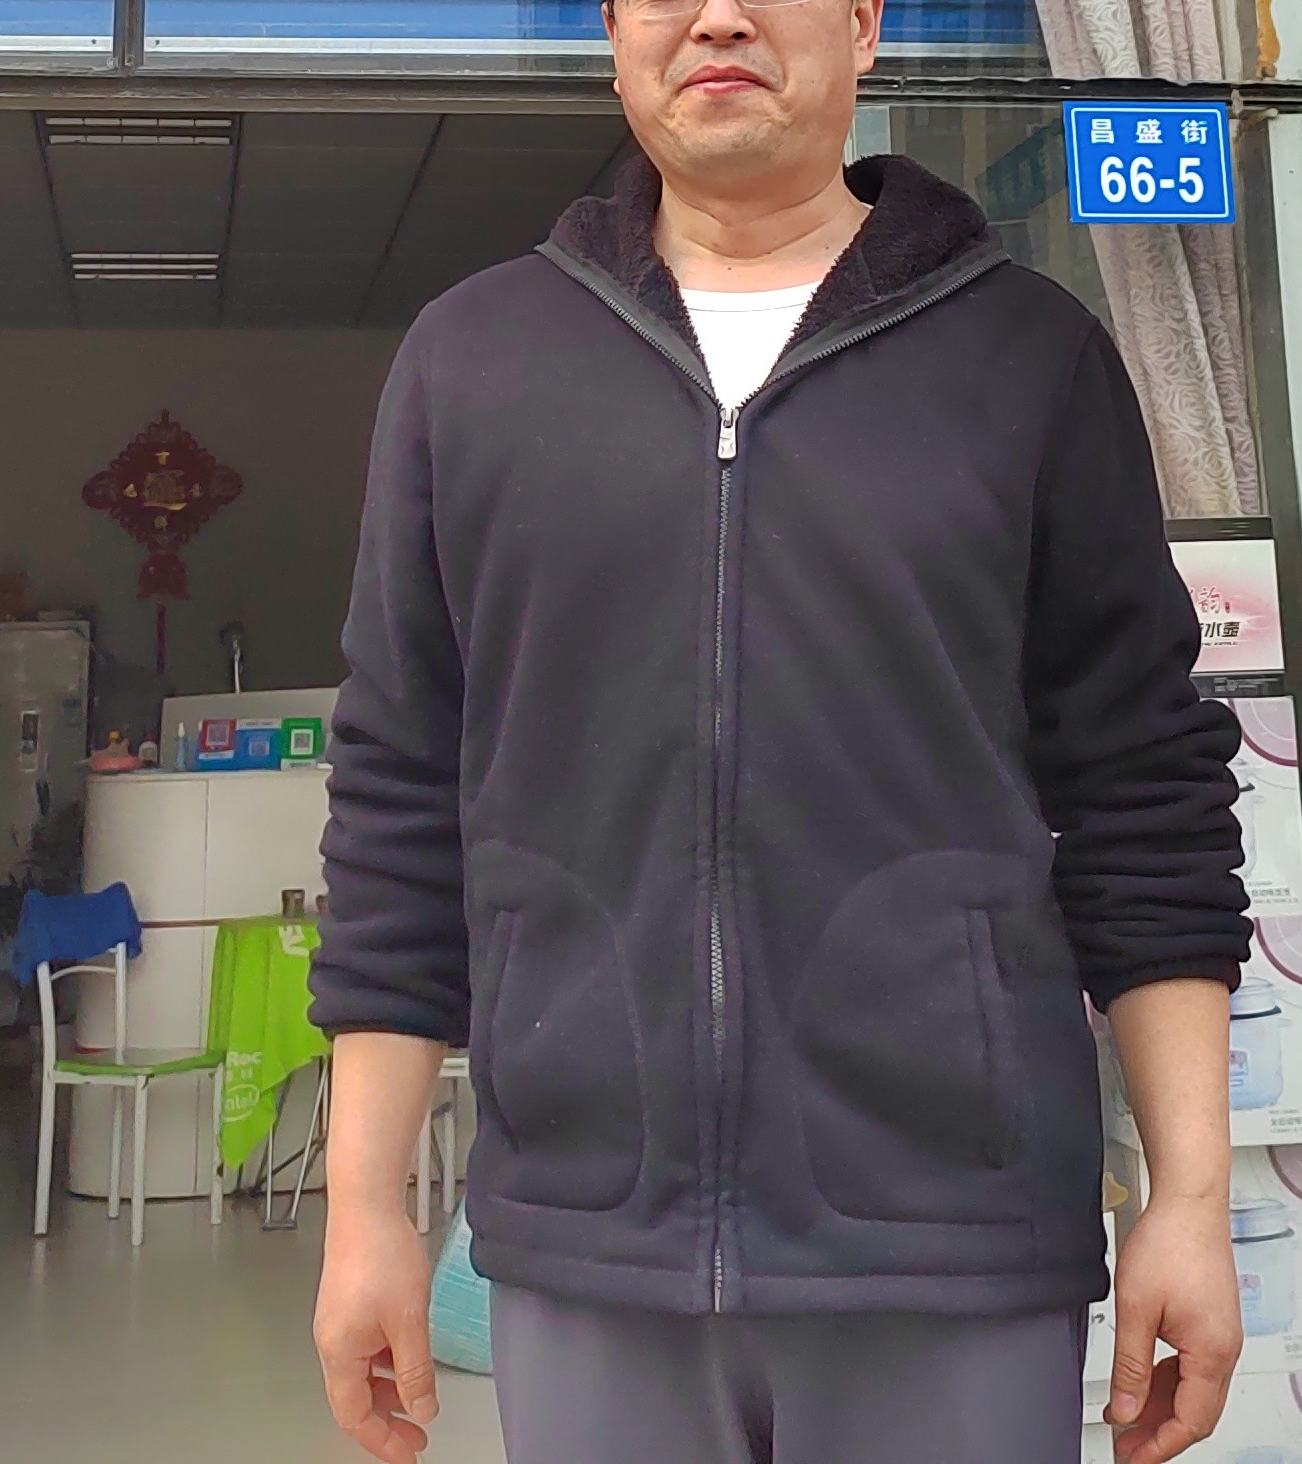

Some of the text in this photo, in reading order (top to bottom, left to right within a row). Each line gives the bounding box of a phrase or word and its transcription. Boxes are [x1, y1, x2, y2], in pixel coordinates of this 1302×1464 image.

[1089, 118, 1208, 145] 昌盛街
[1099, 156, 1205, 204] 66-5
[1189, 586, 1220, 614] 韵
